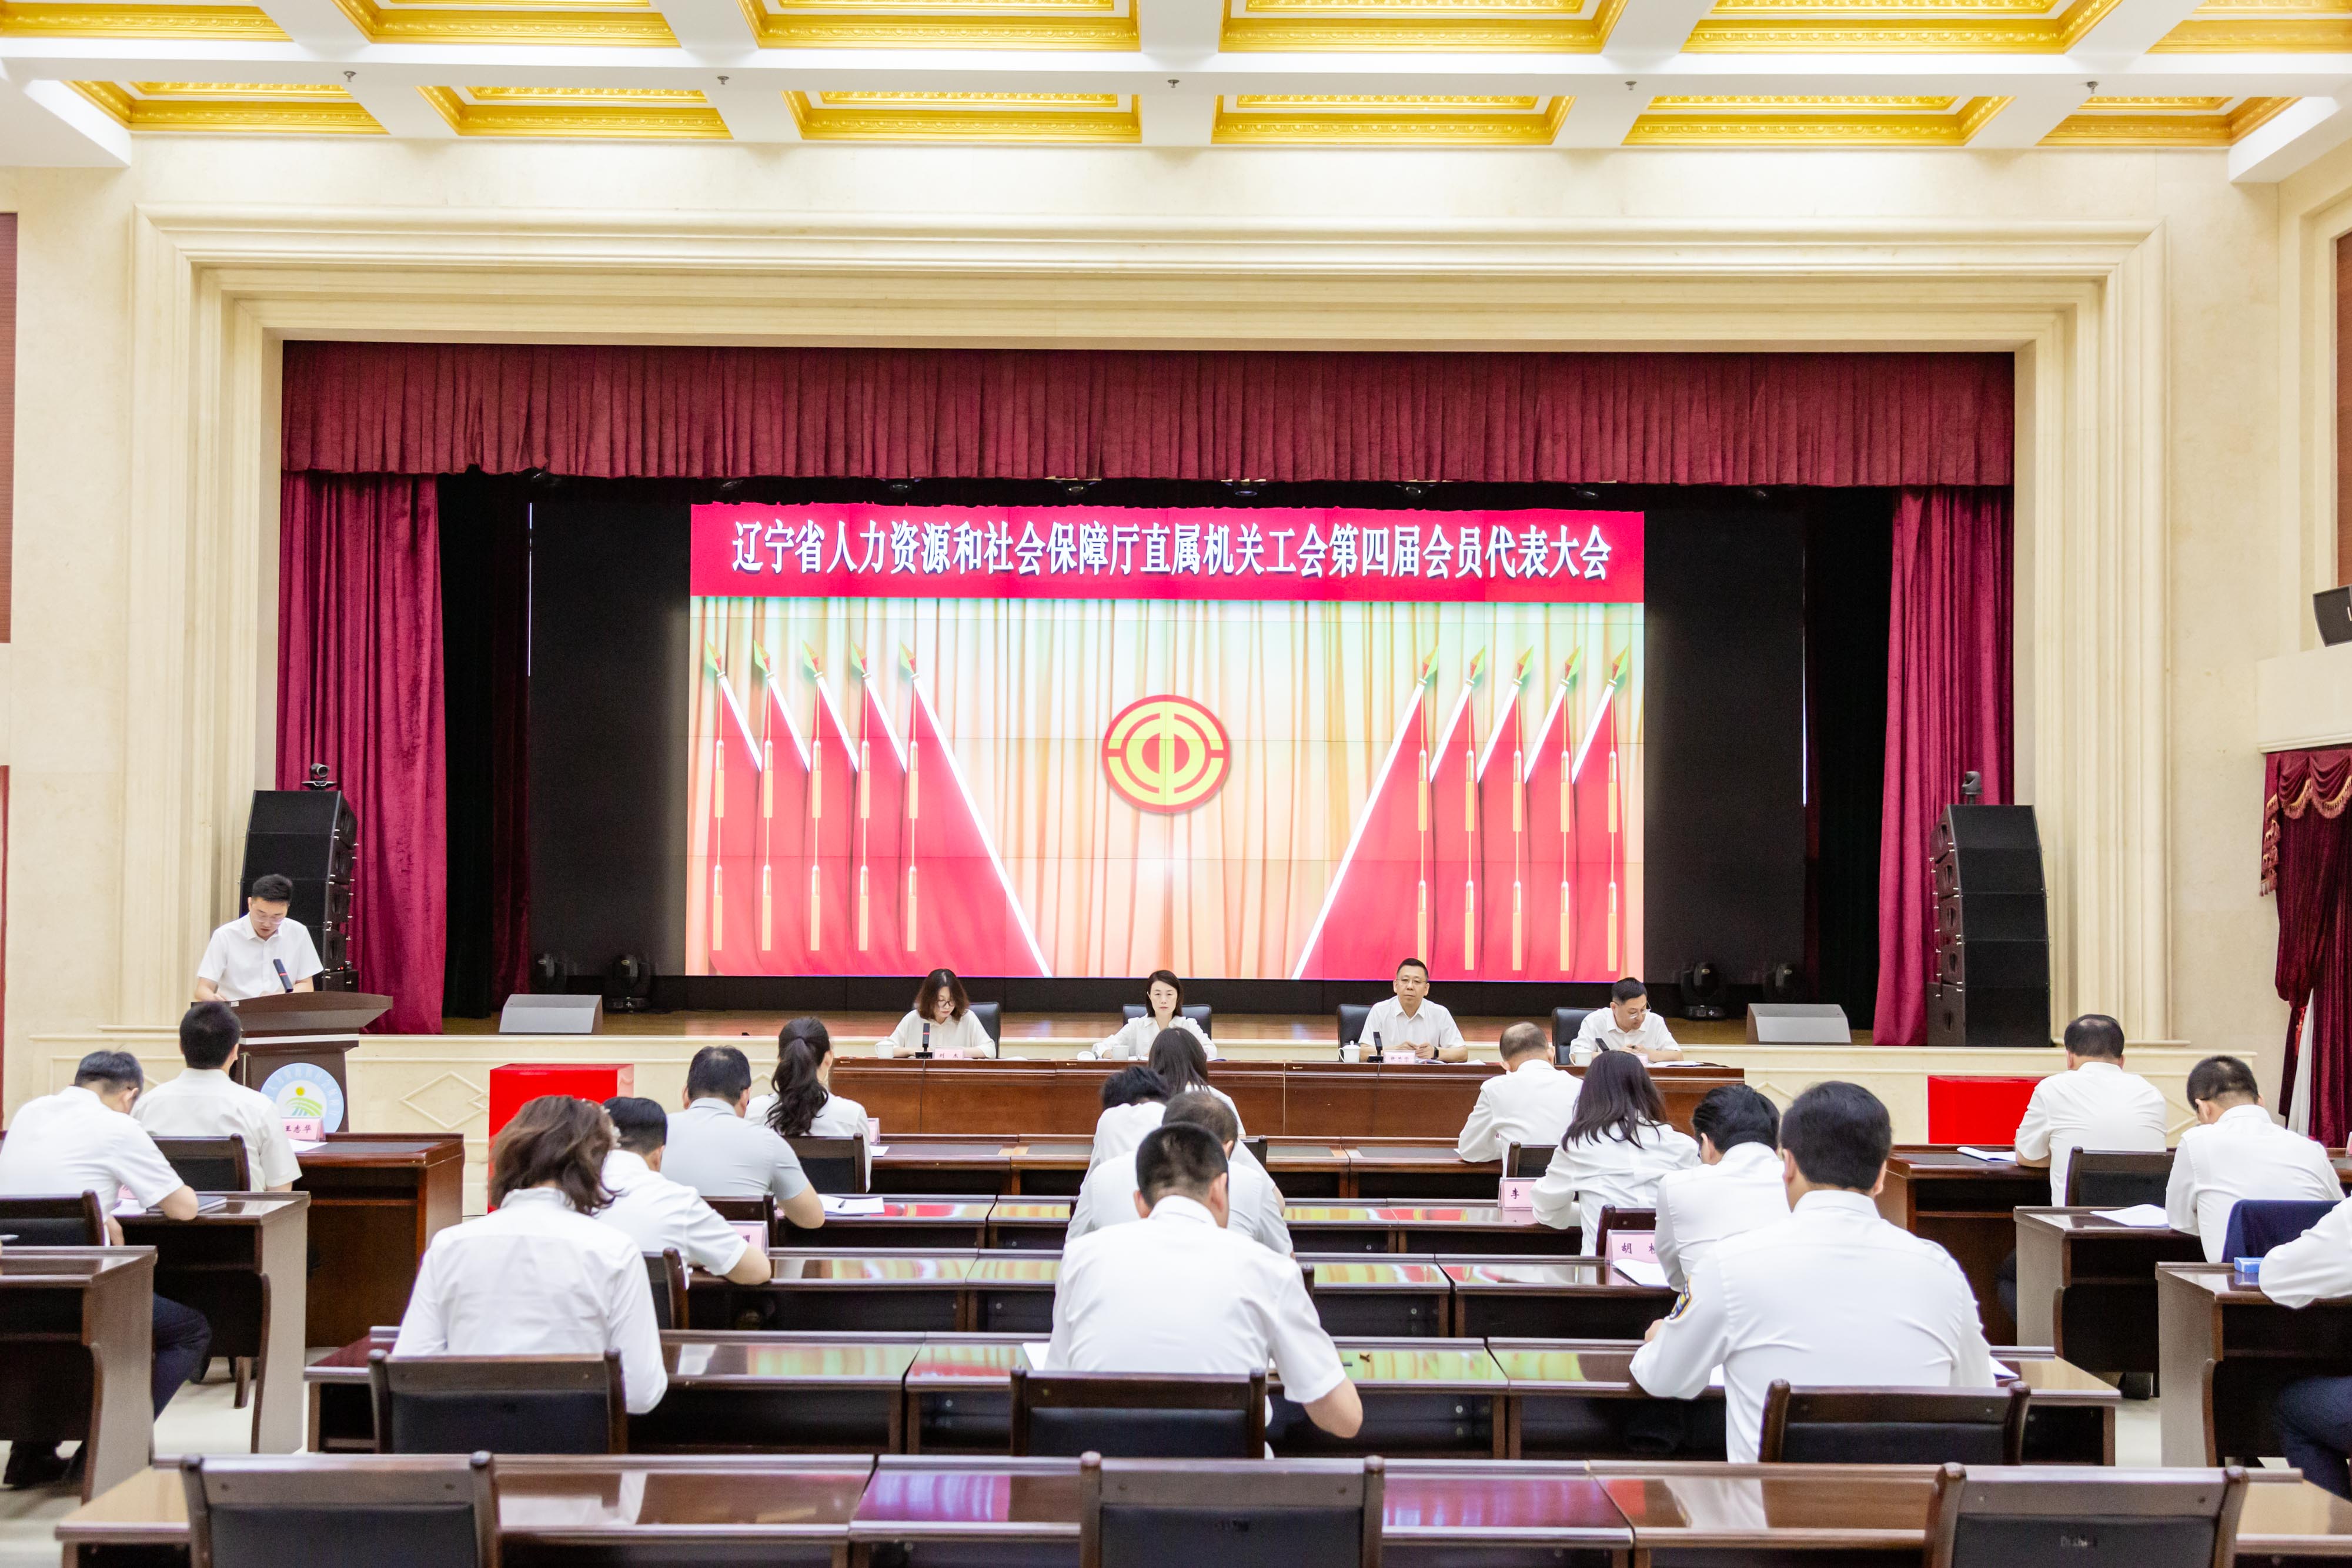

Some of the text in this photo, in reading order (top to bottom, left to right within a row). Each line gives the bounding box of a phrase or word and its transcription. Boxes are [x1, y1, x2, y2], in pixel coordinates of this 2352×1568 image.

[731, 519, 1612, 580] 辽宁省人力资源和社会保障厅直属机关工会第四届会员代表大会
